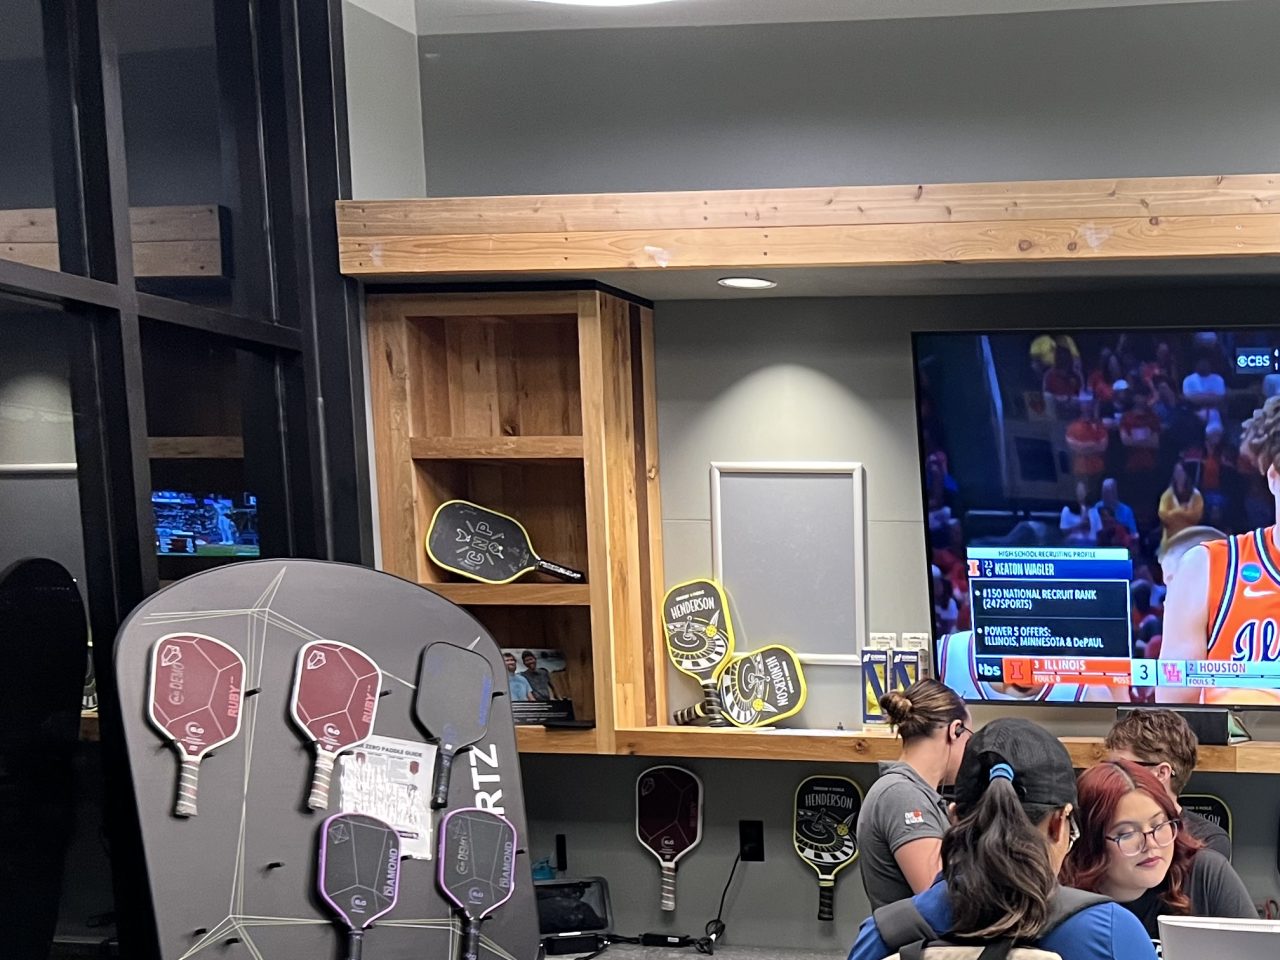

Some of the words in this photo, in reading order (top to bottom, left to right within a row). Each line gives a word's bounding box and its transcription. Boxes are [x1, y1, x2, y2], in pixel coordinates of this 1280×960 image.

[1274, 348, 1279, 357] 4
[1247, 355, 1270, 367] CBS
[1073, 551, 1096, 559] PROFILE
[984, 560, 993, 569] 23
[995, 563, 1024, 576] KEATON
[1024, 563, 1055, 576] WAGLER
[1003, 588, 1041, 599] NATIONAL
[1042, 589, 1074, 600] RECRUIT
[1075, 589, 1097, 600] RANK
[670, 597, 716, 620] HENDERSON
[983, 599, 1032, 610] (247SPORTS)
[984, 626, 1012, 636] POWER
[1020, 626, 1051, 637] OFFERS:
[984, 636, 1019, 647] ILLINOIS,
[1020, 636, 1064, 648] MINNESOTA
[1065, 638, 1072, 647] &
[1073, 638, 1104, 648] DePAUL
[978, 663, 1001, 676] tbs
[1034, 660, 1039, 669] 3
[1044, 659, 1086, 670] ILLINOIS
[1189, 663, 1194, 671] 2
[1199, 662, 1246, 673] HOUSTON
[1139, 665, 1149, 680] 3
[765, 656, 789, 707] HENDERSON
[227, 684, 240, 718] RUBY
[361, 693, 375, 723] RUBY
[365, 743, 381, 752] ZERO
[404, 750, 423, 758] GUIDE
[804, 793, 853, 810] HENDERSON
[499, 840, 513, 888] DIAMOND
[383, 847, 399, 897] DIAMOND
